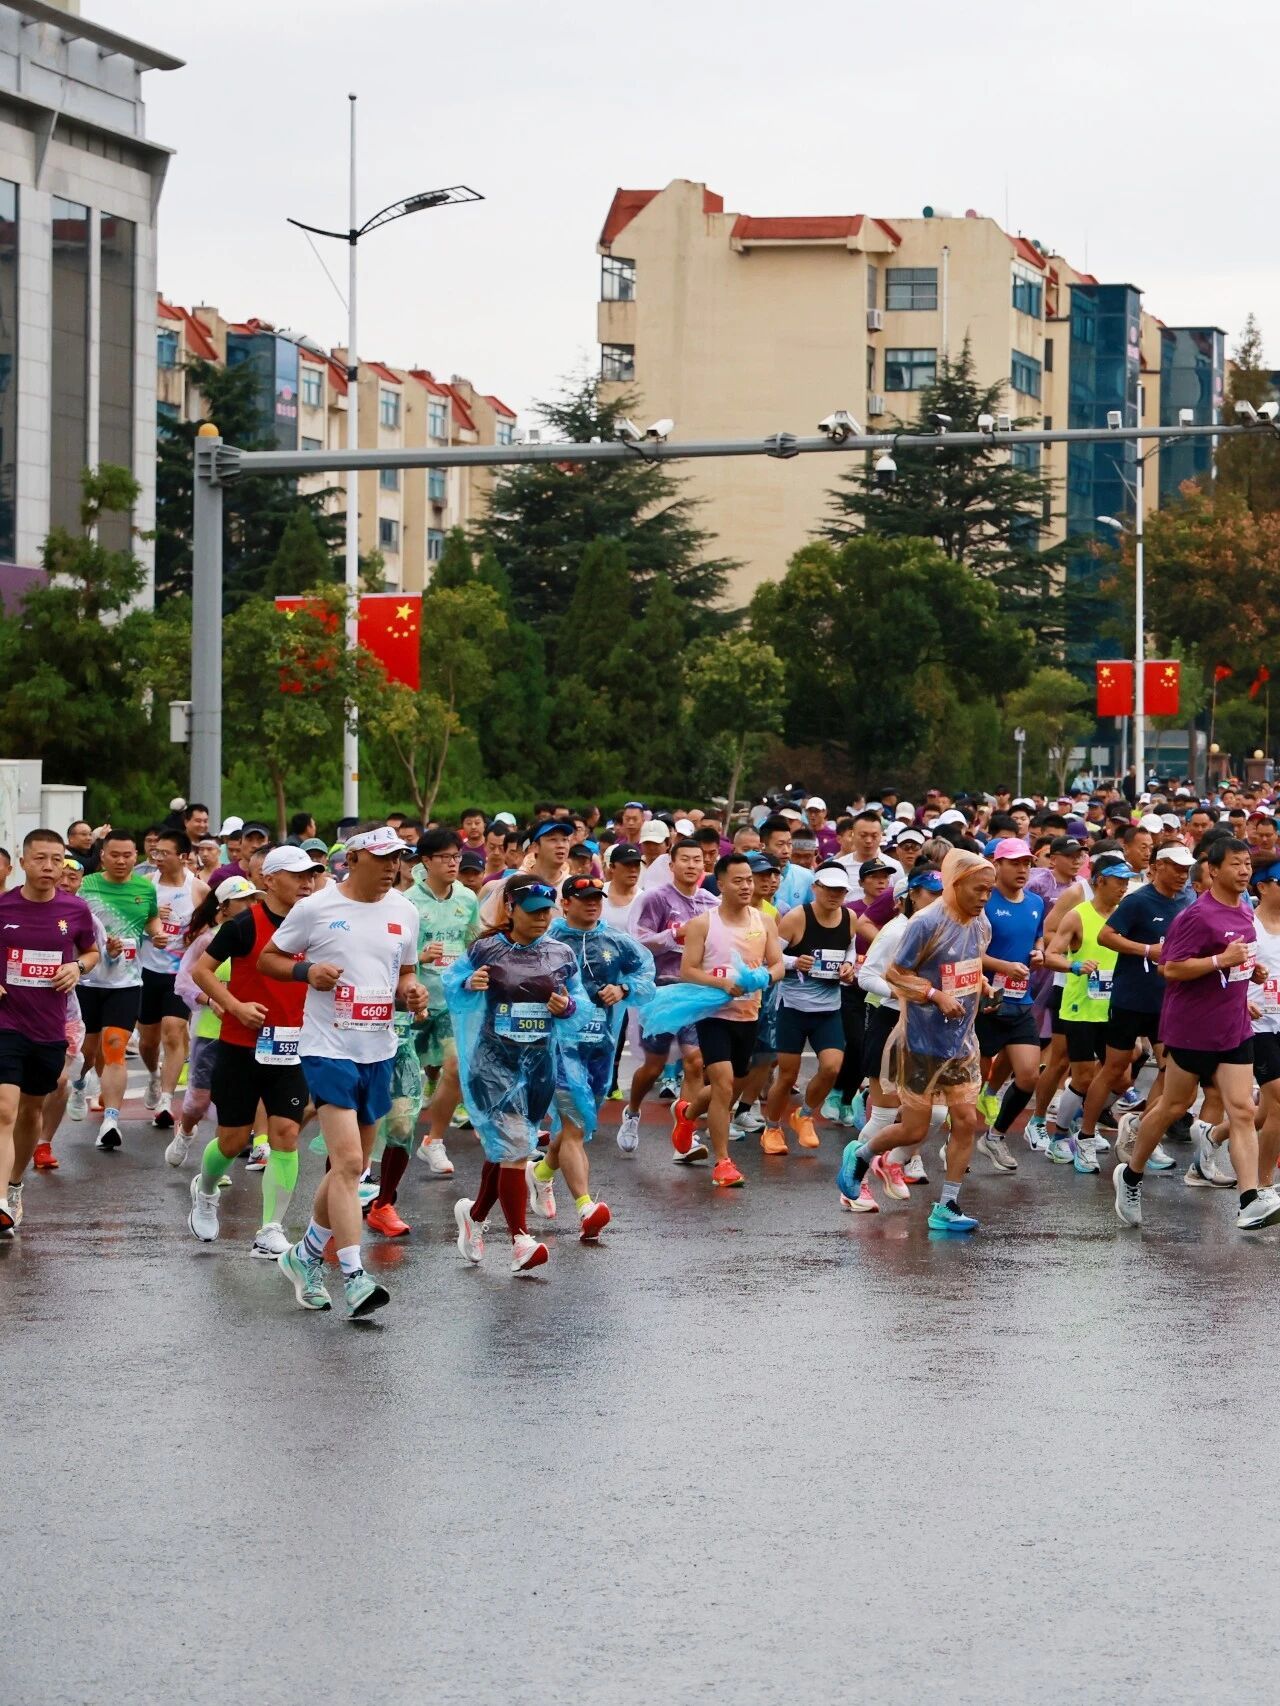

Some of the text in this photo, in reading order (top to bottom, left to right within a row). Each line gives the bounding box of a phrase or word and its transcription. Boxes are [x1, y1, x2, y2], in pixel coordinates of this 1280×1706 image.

[12, 950, 19, 959] B
[826, 962, 841, 970] 067
[945, 965, 952, 973] B
[29, 966, 54, 976] 0323
[717, 969, 723, 978] B
[1267, 981, 1274, 989] B
[341, 987, 350, 998] B
[361, 1006, 388, 1017] 6609
[500, 1004, 508, 1013] B
[518, 1019, 545, 1030] 5018
[262, 1027, 270, 1037] B
[279, 1043, 297, 1053] 5532
